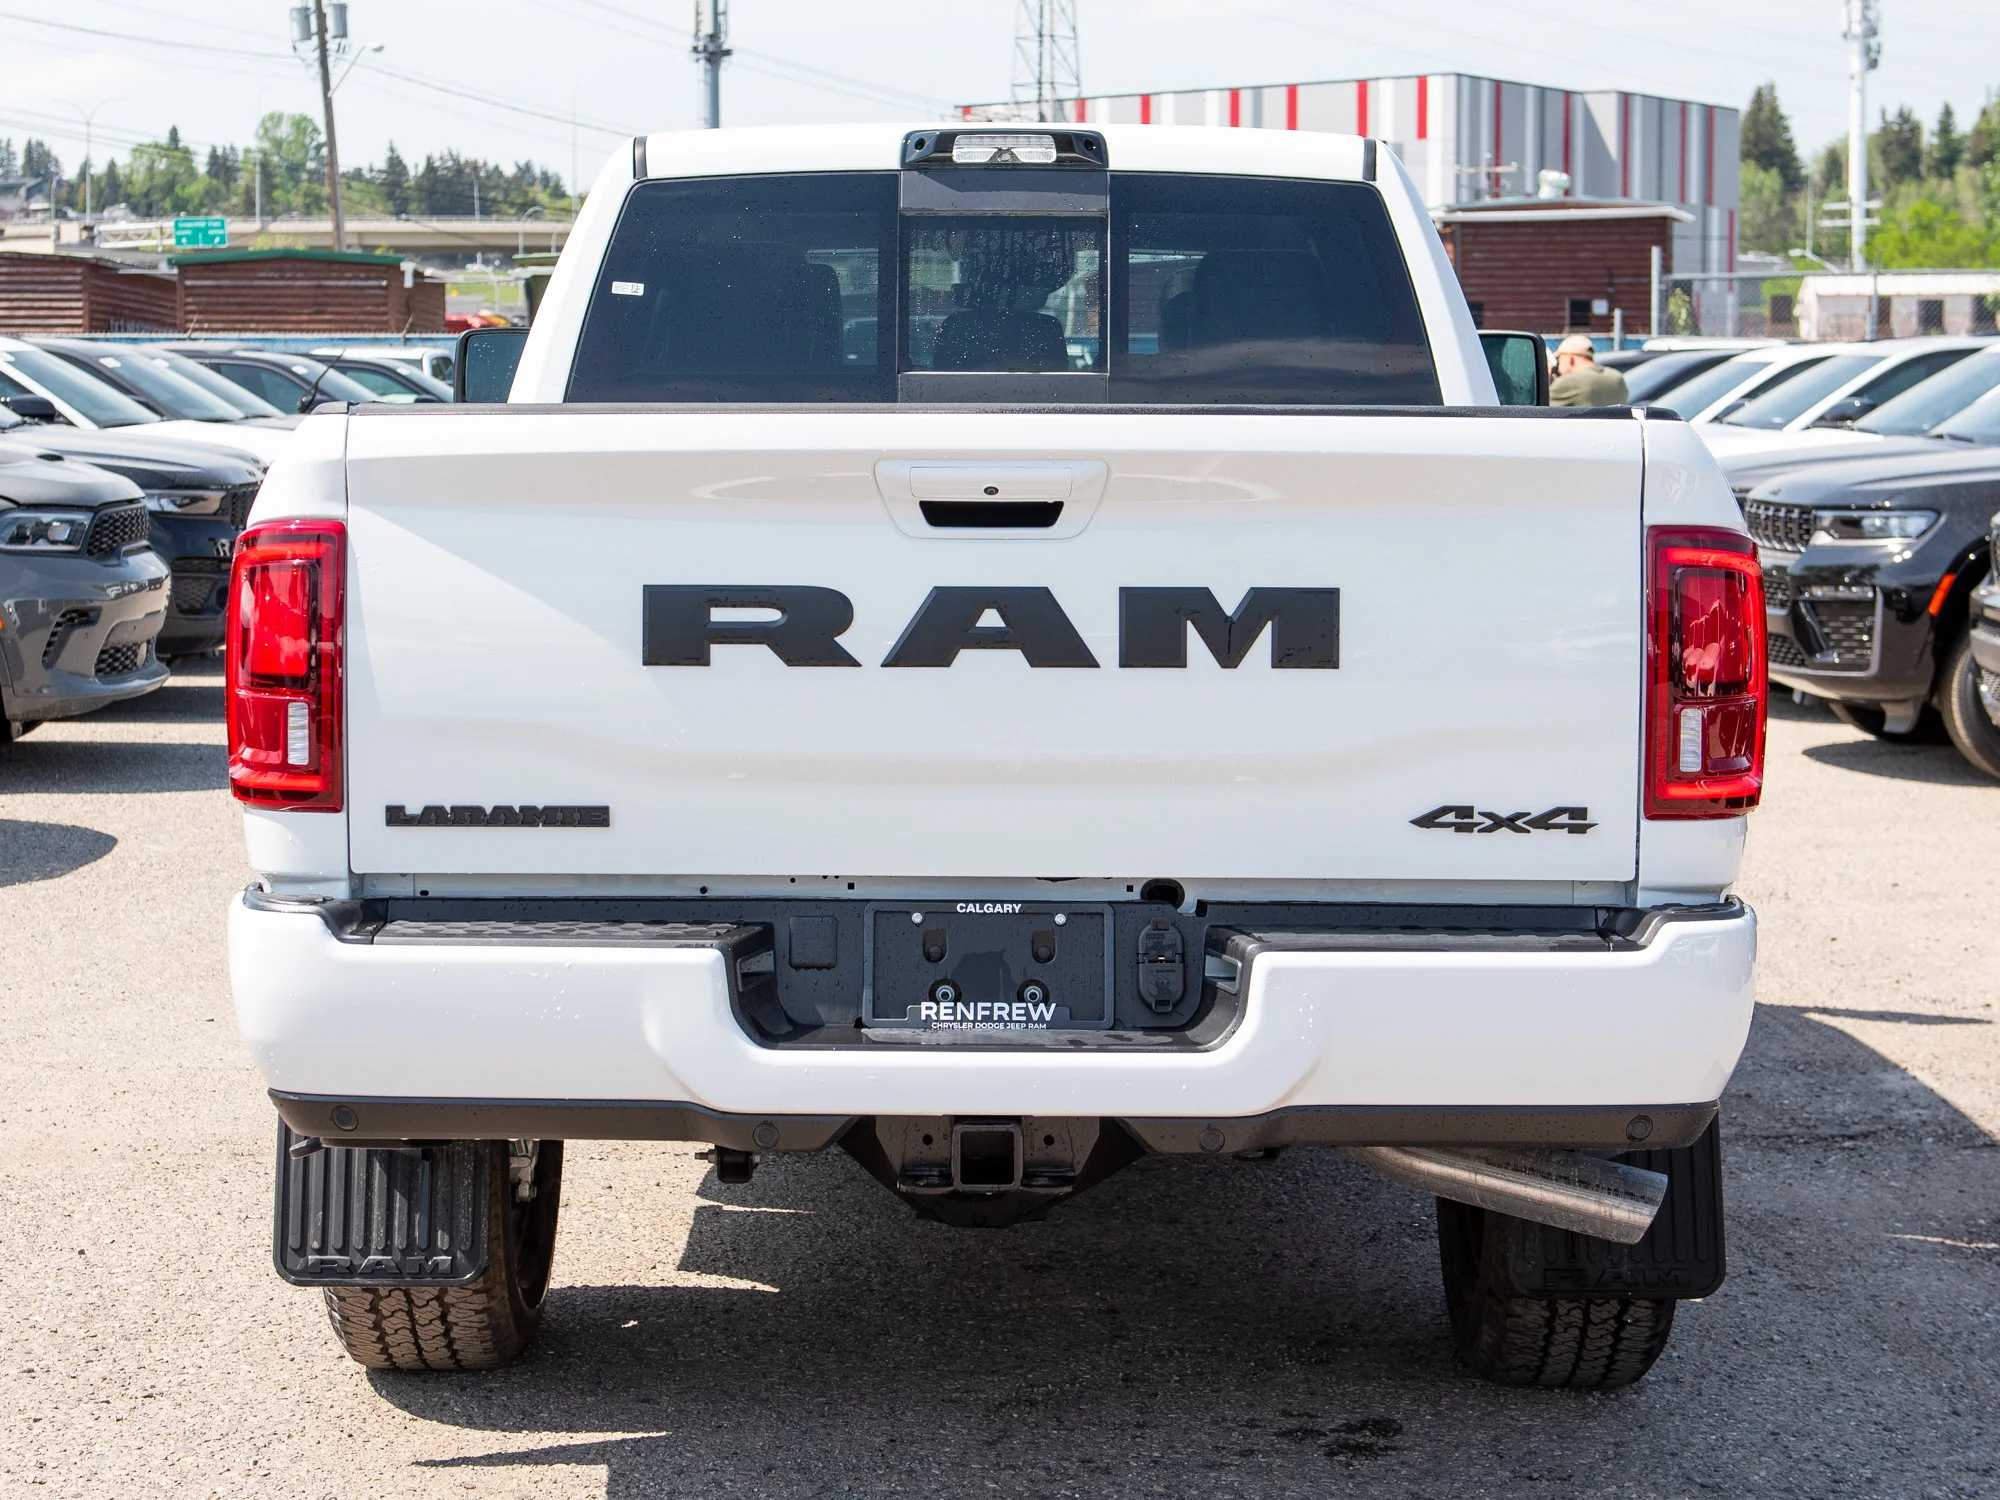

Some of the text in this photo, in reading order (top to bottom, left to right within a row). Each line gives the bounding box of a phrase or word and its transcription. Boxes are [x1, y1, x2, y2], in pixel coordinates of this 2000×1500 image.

[643, 584, 1341, 669] RAM
[385, 805, 610, 827] LARAMIE
[1408, 804, 1599, 834] 4x4
[956, 903, 1022, 914] CALGARY
[920, 1001, 1057, 1021] RENFREW
[931, 1022, 974, 1030] CHRYSLER
[975, 1022, 1005, 1030] DODGE
[307, 1256, 453, 1274] RAM
[1543, 1268, 1692, 1288] RAM
